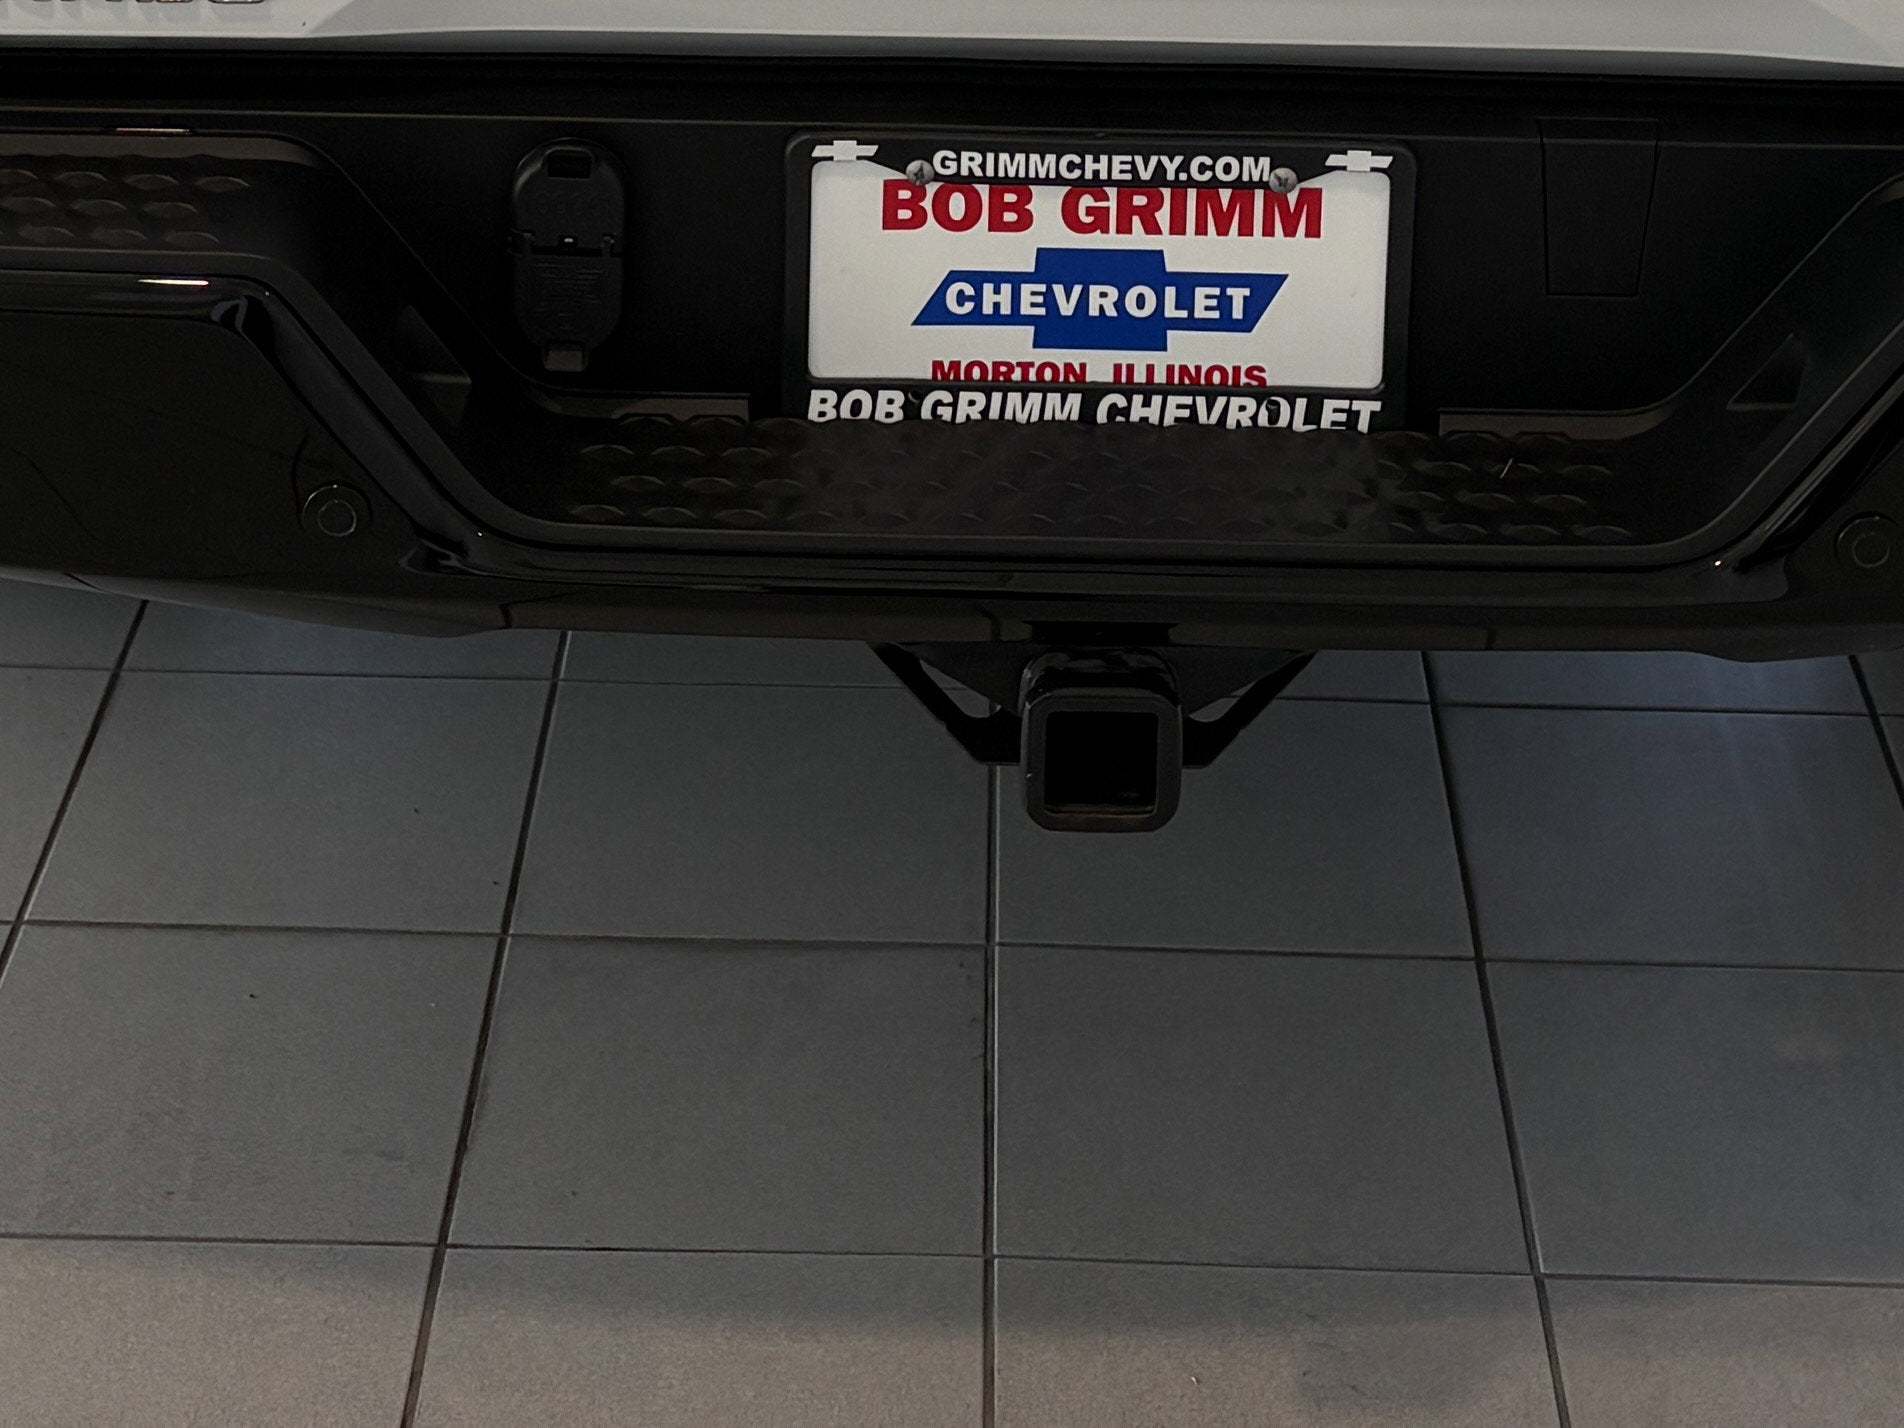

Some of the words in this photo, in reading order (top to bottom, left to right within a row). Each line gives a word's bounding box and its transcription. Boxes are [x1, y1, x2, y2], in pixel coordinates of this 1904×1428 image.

[932, 150, 1272, 182] GRIMMCHEVY.COM
[882, 179, 1034, 233] BOB
[1061, 186, 1323, 238] GRIMM
[945, 281, 1251, 320] CHEVROLET
[807, 389, 905, 425] BOB
[920, 390, 1083, 425] GRIMM
[1095, 393, 1382, 434] CHEVROLET
